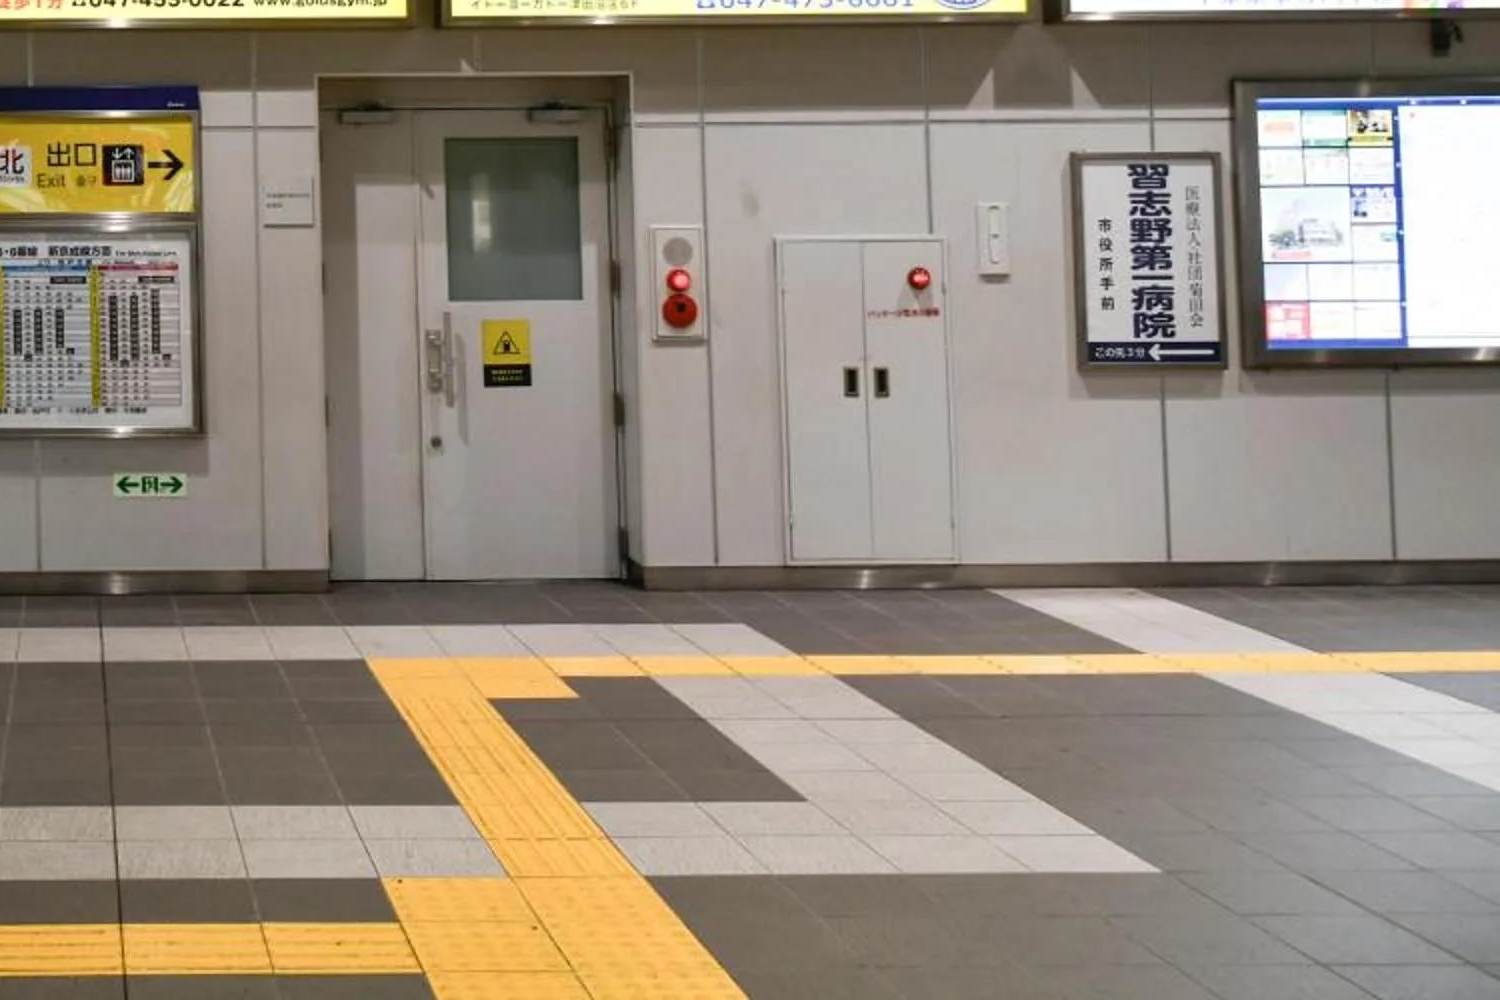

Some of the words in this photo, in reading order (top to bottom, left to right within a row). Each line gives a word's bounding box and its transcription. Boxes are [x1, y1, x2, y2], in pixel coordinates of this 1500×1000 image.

[37, 173, 66, 188] Exit
[47, 141, 97, 167] 出口
[1097, 217, 1116, 311] 市役所手前
[1127, 163, 1176, 339] 習志野第一病院
